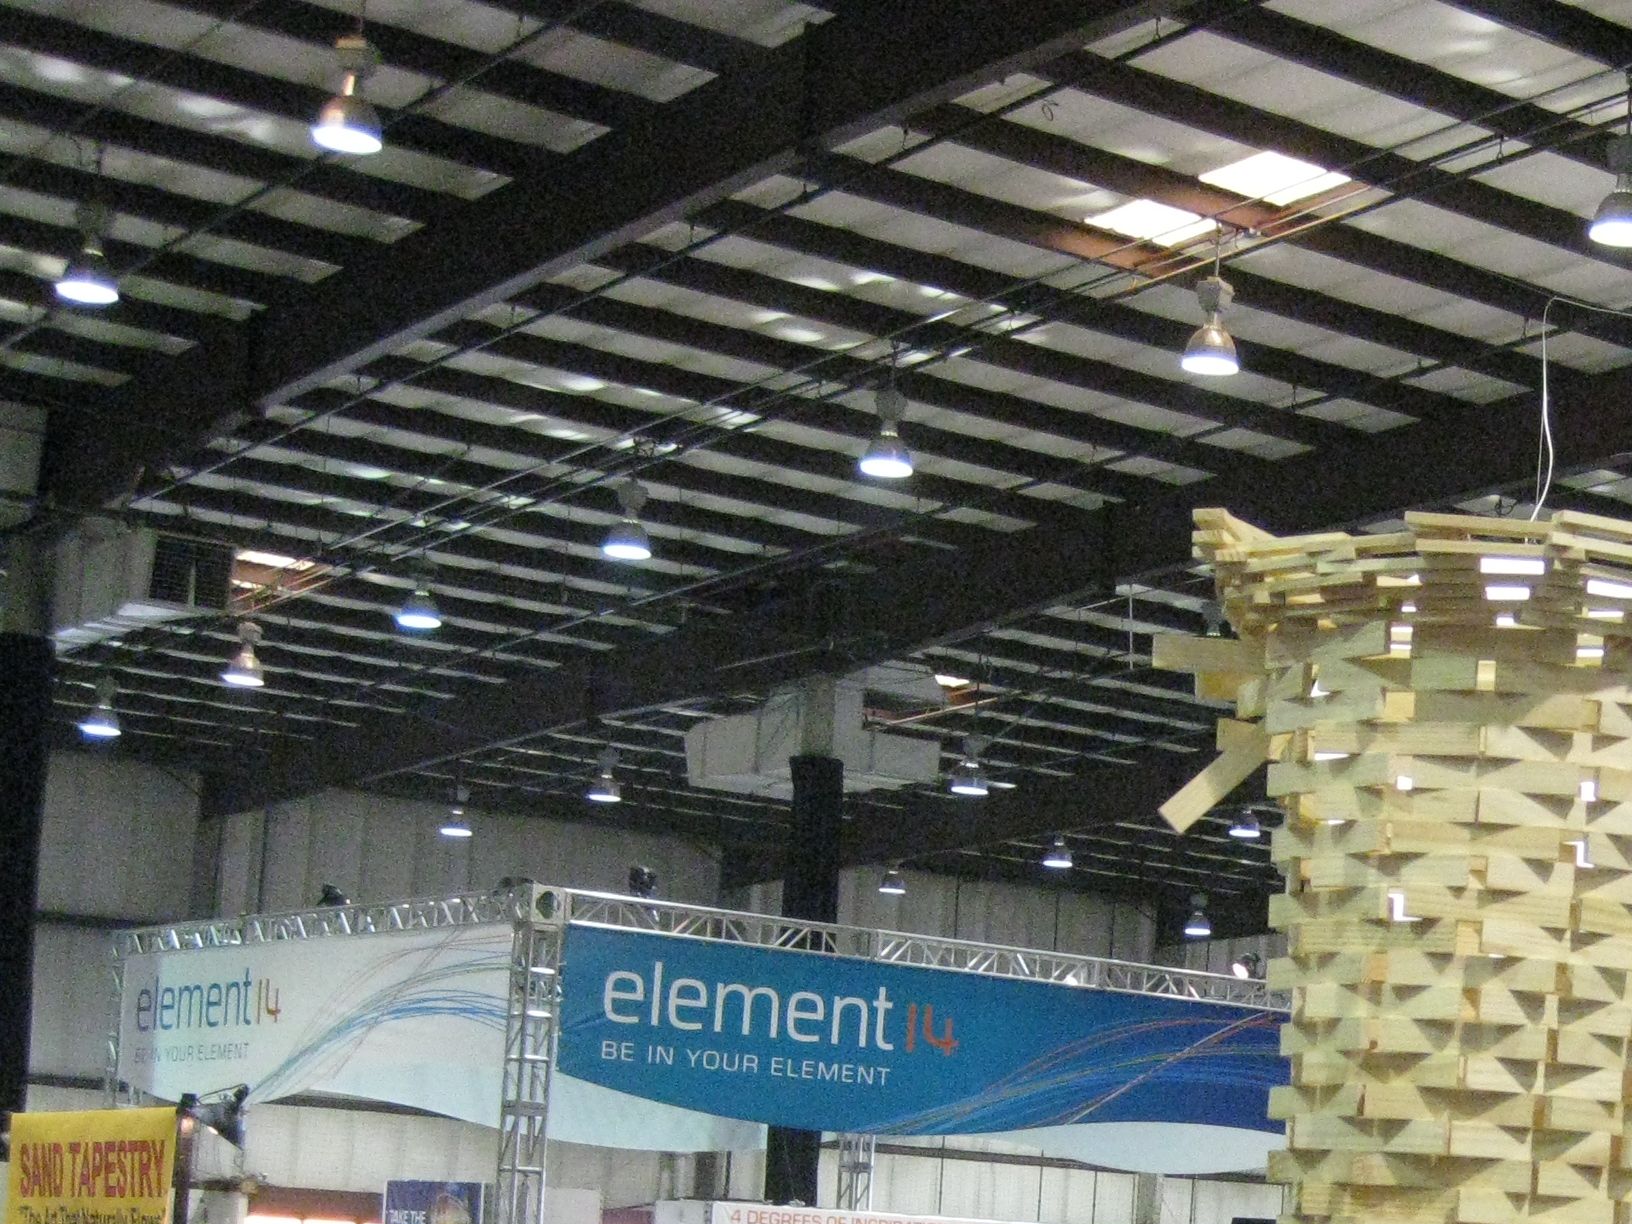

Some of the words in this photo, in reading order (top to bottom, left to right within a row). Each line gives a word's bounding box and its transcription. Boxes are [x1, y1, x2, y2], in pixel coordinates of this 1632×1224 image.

[165, 1044, 194, 1062] YOUR
[198, 1042, 249, 1061] ELEMENT
[600, 1041, 635, 1062] BE
[648, 1046, 674, 1065] IN
[688, 1050, 759, 1073] YOUR
[771, 1057, 891, 1086] ELEMENT
[20, 1142, 64, 1198] SAND
[69, 1139, 165, 1198] TAPESTRY
[731, 1209, 741, 1224] 4
